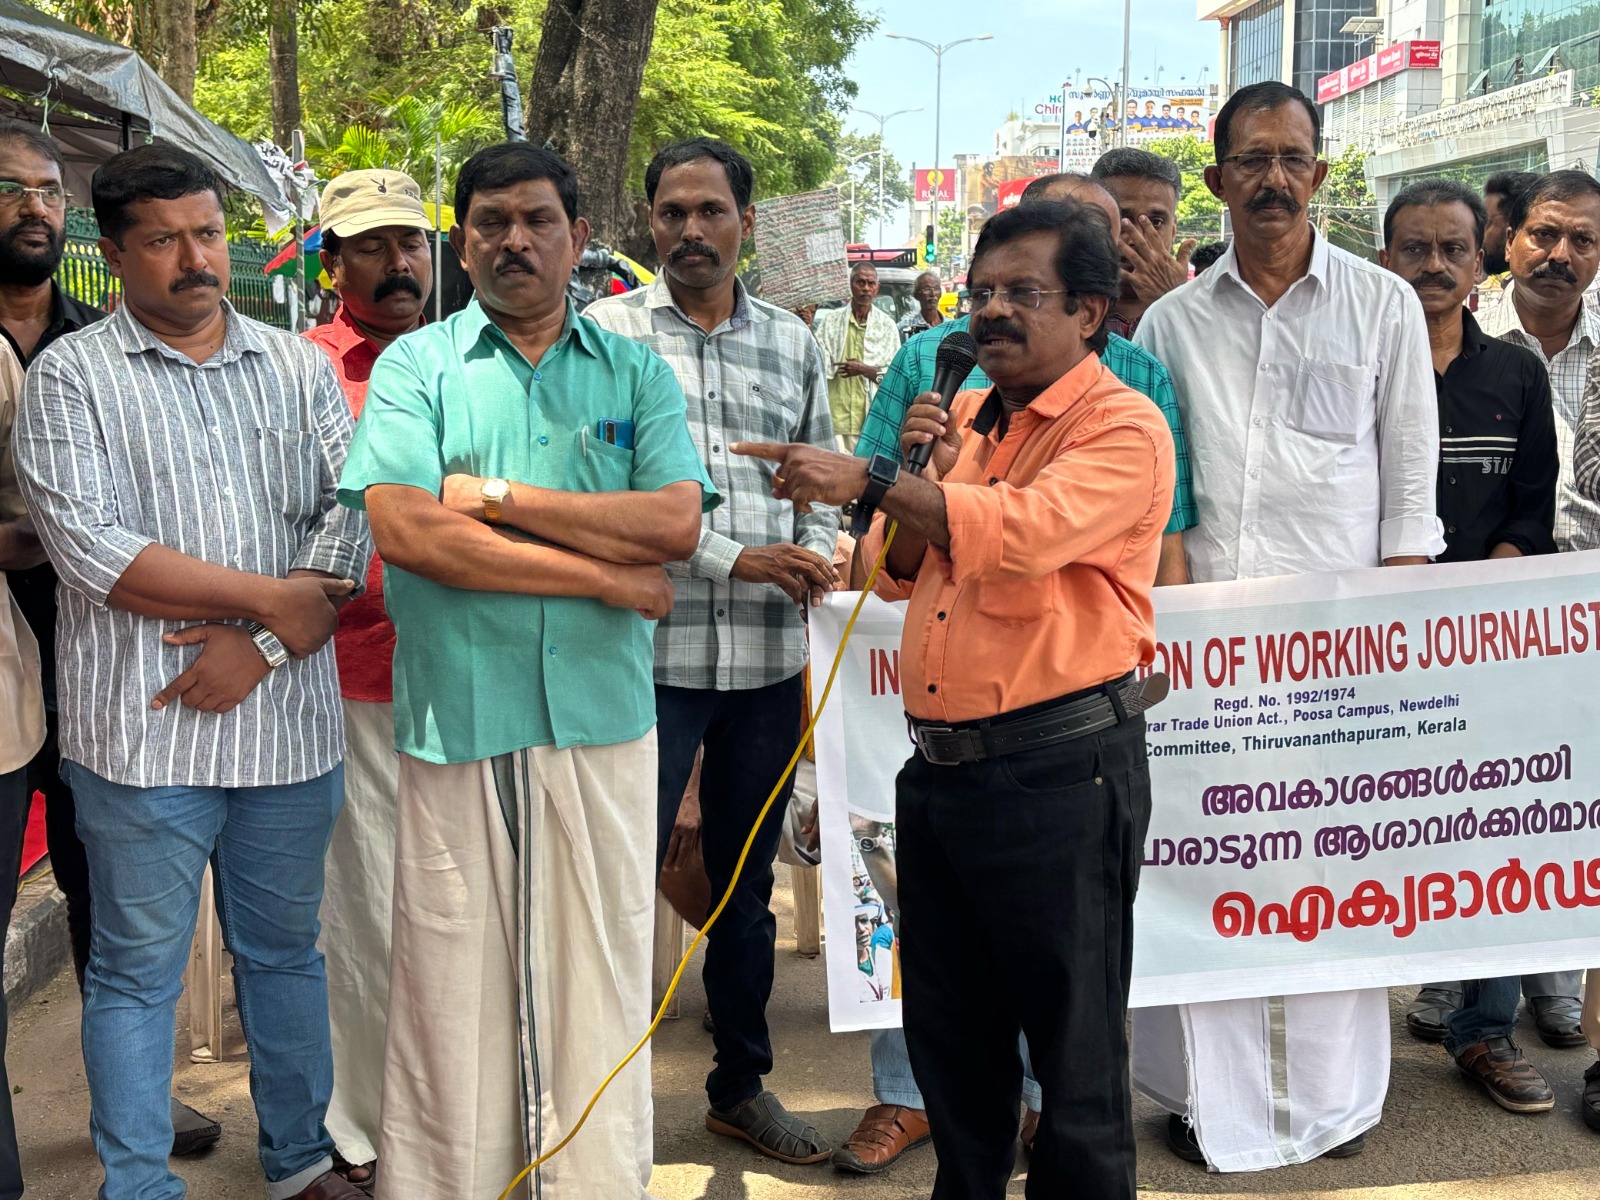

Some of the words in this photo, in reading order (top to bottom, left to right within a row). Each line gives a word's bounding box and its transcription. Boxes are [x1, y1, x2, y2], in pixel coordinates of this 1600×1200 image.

[870, 648, 899, 696] IN
[1139, 641, 1192, 690] ON
[1204, 636, 1246, 688] OF
[1255, 621, 1408, 684] WORKING
[1417, 601, 1600, 669] JOURNALIST
[1147, 721, 1167, 732] rar
[1171, 717, 1209, 731] Trade
[1214, 715, 1252, 729] Union
[1257, 712, 1288, 725] Act.,
[1293, 709, 1333, 722] Poosa
[1337, 704, 1394, 719] Campus,
[1399, 694, 1459, 712] Newdelhi
[1214, 696, 1253, 712] Regd.
[1258, 694, 1281, 707] No.
[1287, 687, 1356, 705] 1992/1974
[1145, 739, 1236, 757] Committee,
[1242, 726, 1411, 751] Thiruvananthapuram,
[1418, 717, 1467, 735] Kerala
[1202, 744, 1571, 816] അവകാശങ്ങൾക്കായി
